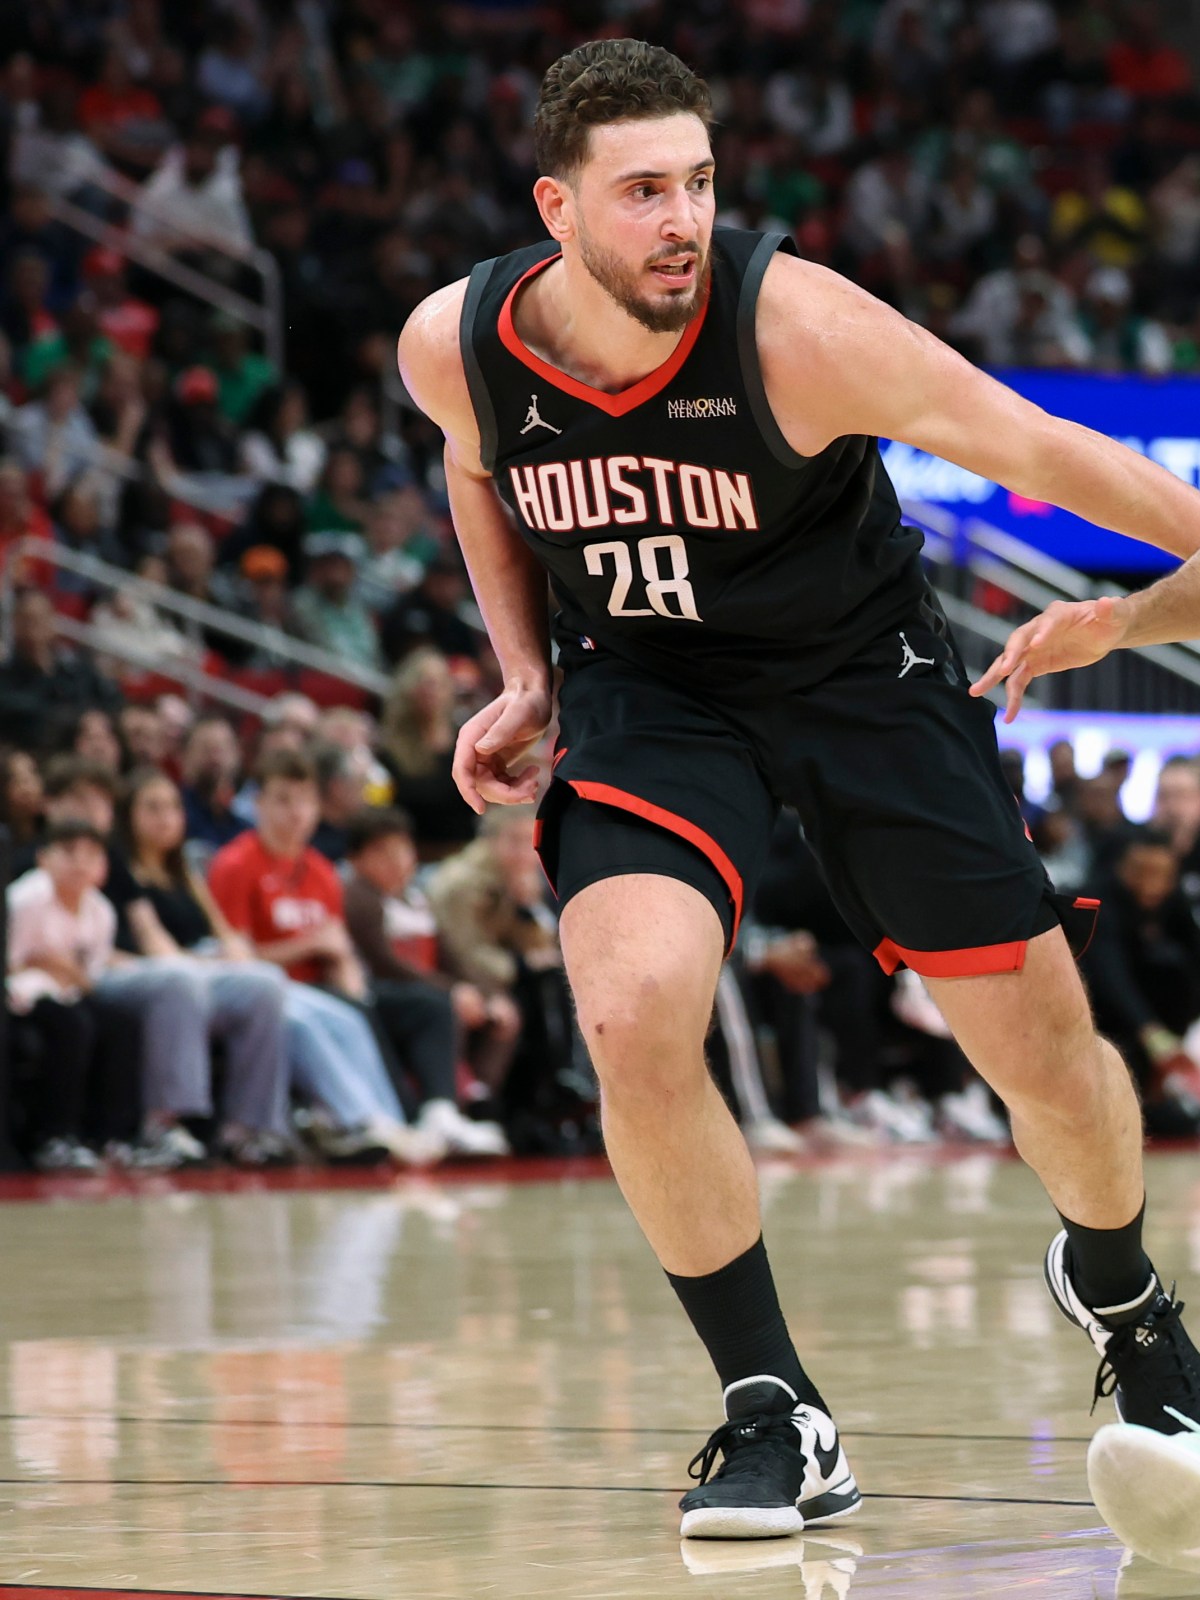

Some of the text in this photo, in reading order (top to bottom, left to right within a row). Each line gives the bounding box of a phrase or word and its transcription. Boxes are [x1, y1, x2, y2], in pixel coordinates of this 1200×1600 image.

[668, 397, 736, 410] MEMORIAL
[668, 405, 736, 418] HERMANN
[509, 455, 760, 532] HOUSTON
[583, 535, 703, 622] 28
